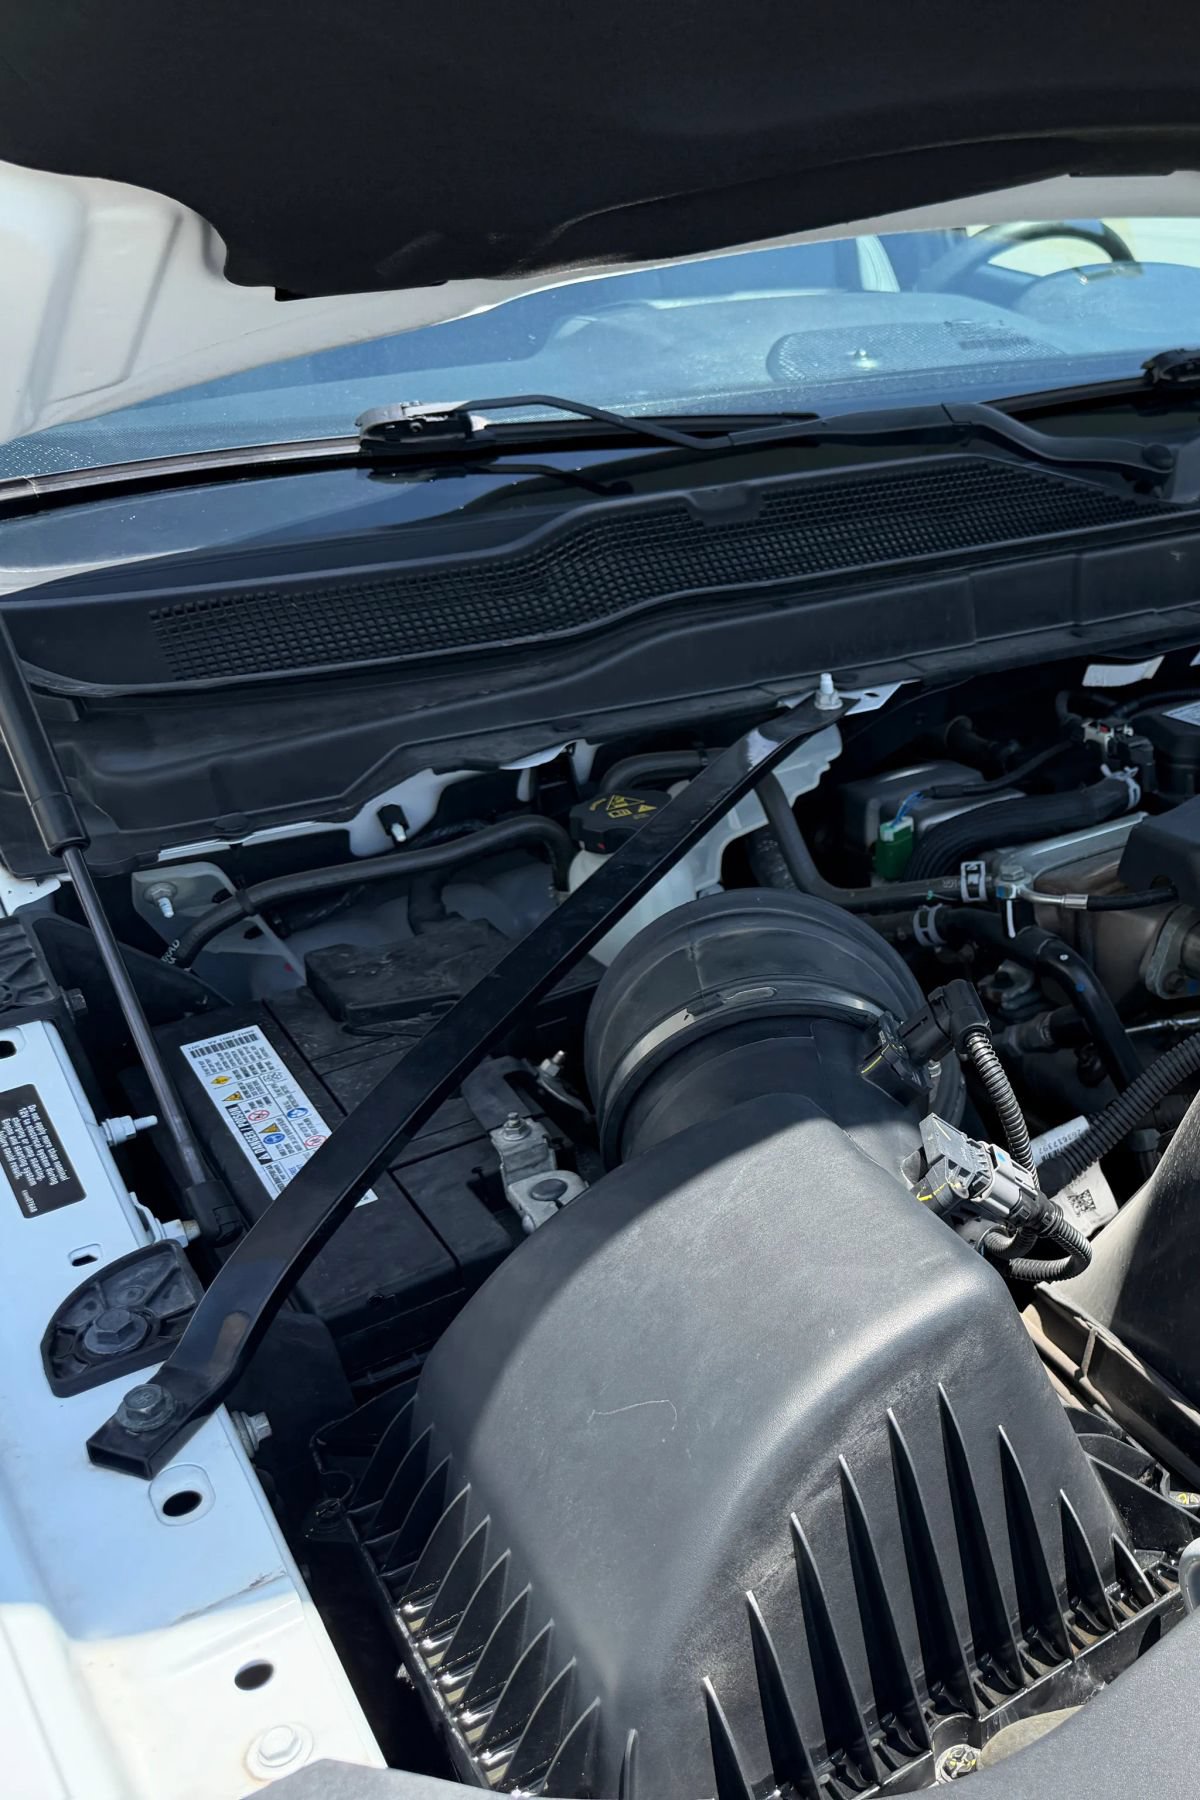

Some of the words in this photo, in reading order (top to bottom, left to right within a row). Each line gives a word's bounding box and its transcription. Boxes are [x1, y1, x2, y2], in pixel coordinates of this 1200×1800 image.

[27, 1103, 37, 1114] Do
[31, 1112, 41, 1122] not
[1, 1117, 14, 1136] Engine
[34, 1121, 48, 1135] apply
[9, 1135, 22, 1146] and
[11, 1117, 27, 1139] charging
[22, 1144, 36, 1158] jump
[41, 1134, 53, 1149] more
[18, 1107, 31, 1118] 12V
[25, 1124, 45, 1150] electrical
[36, 1148, 51, 1169] system
[45, 1167, 59, 1186] during
[47, 1147, 58, 1161] than
[3, 1147, 18, 1162] could
[13, 1145, 29, 1168] starting
[23, 1166, 37, 1187] system
[53, 1160, 71, 1182] nominal
